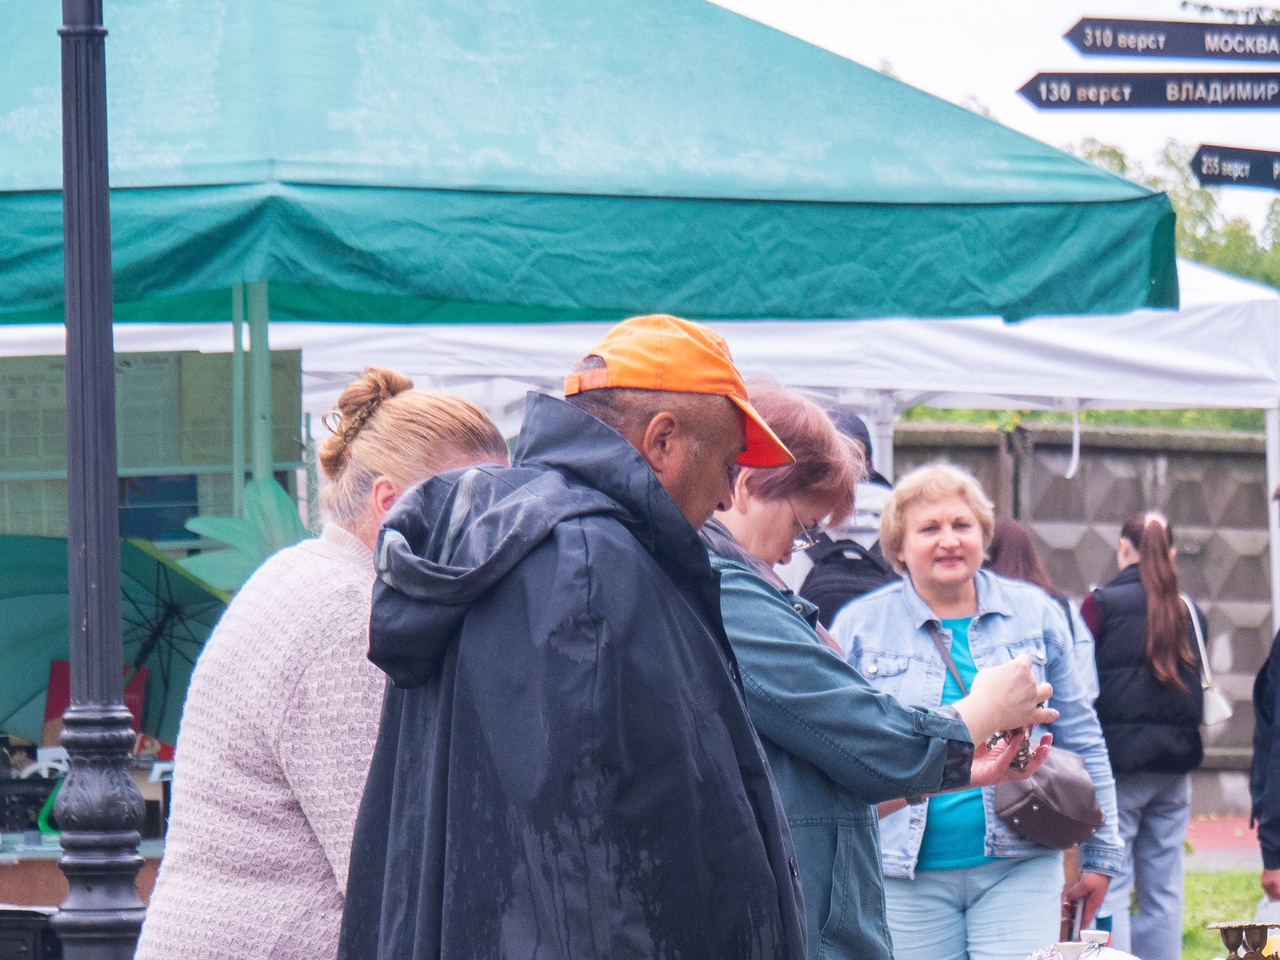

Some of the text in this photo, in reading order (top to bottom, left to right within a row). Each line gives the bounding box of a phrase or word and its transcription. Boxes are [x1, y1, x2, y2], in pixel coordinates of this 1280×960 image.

[1083, 27, 1280, 54] 310 верст МОСКВА
[1038, 81, 1280, 105] 130 верст ВЛАДИМИР
[1221, 160, 1251, 181] верст
